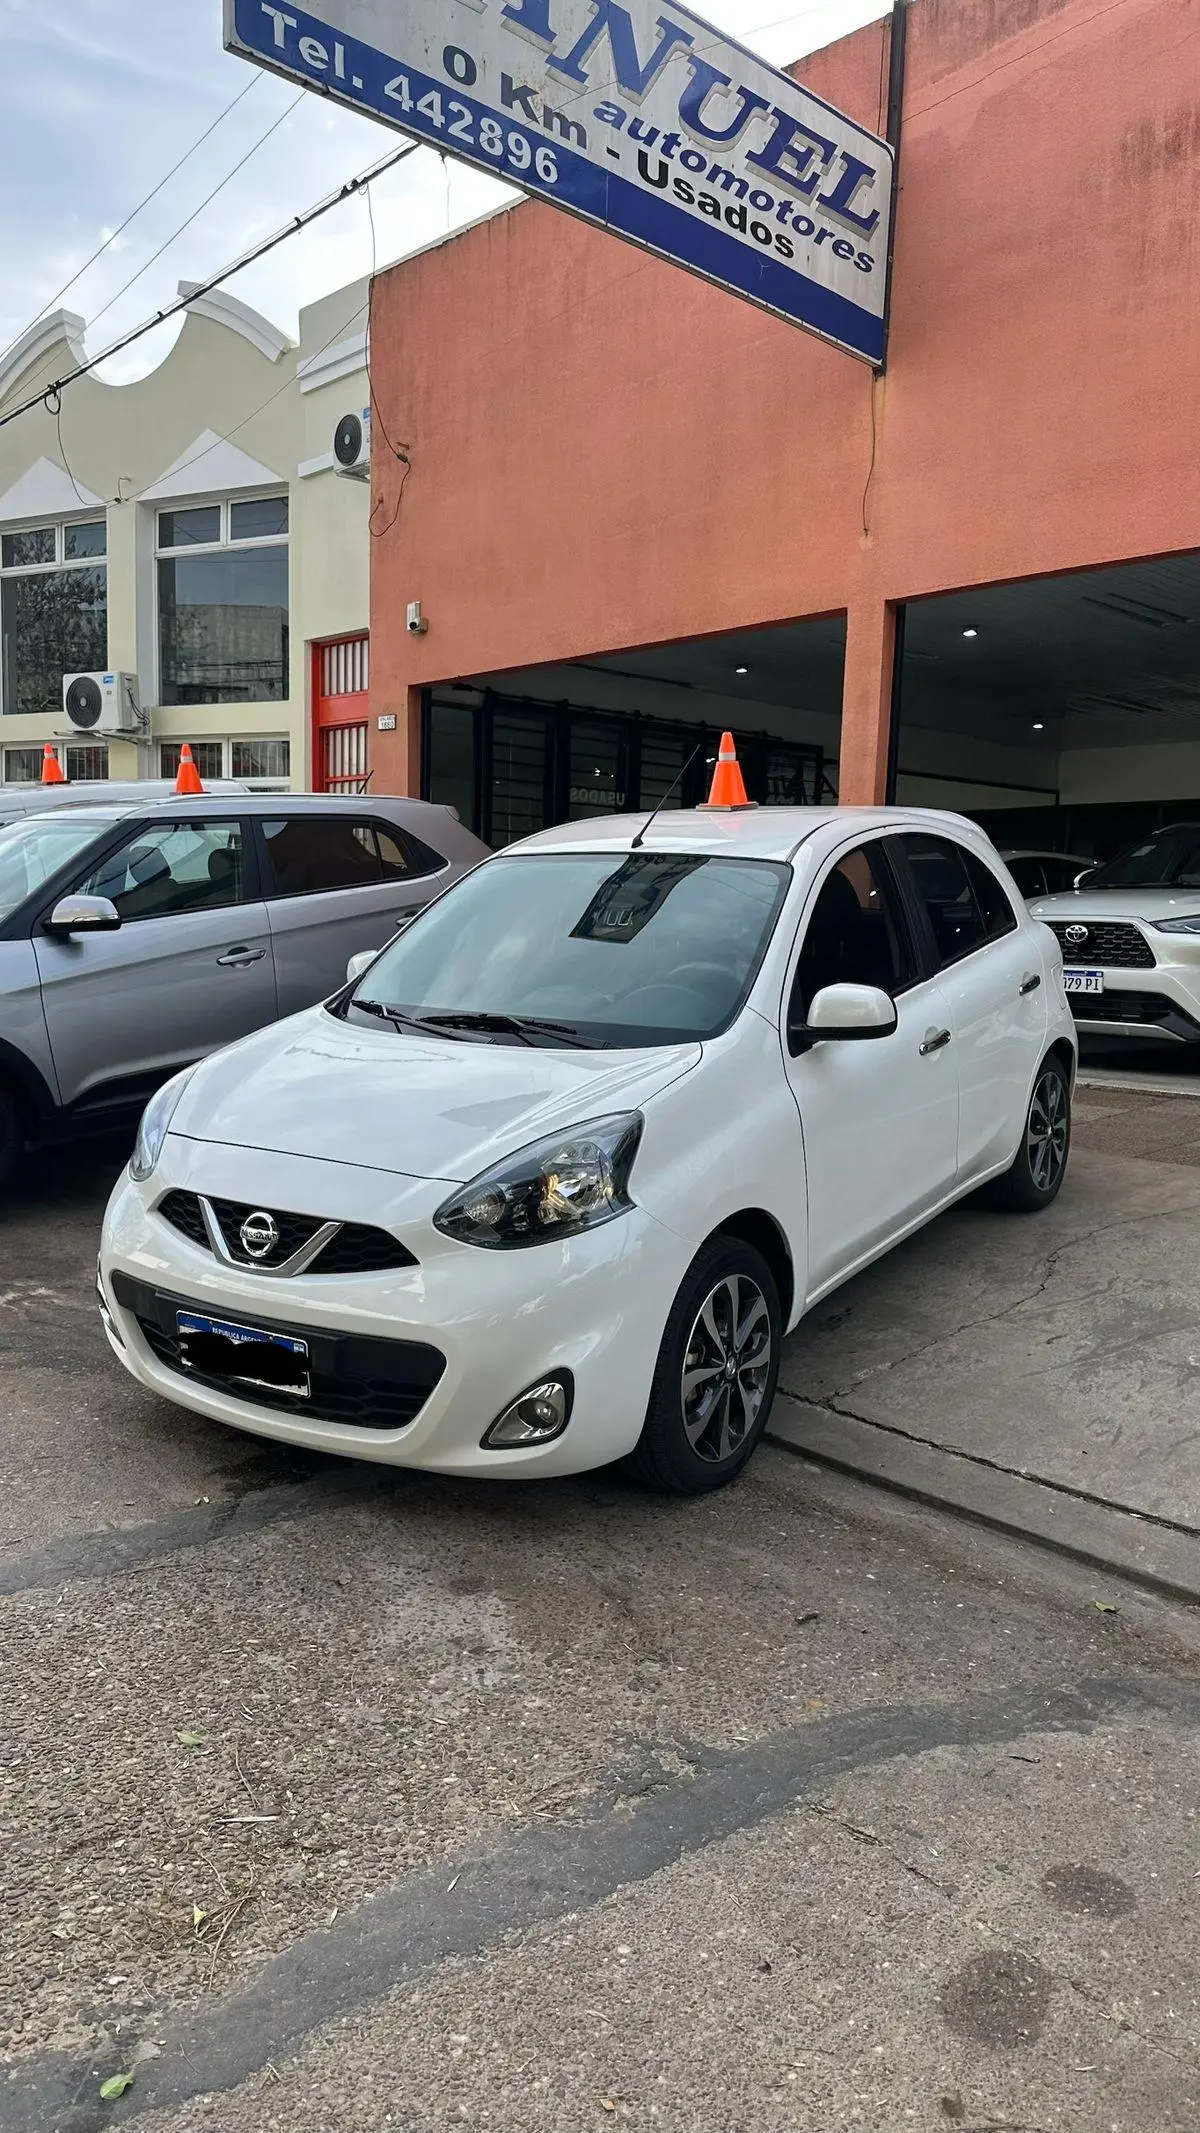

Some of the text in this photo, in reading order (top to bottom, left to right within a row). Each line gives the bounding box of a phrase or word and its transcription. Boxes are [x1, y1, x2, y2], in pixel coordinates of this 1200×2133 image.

[261, 5, 558, 184] Tel. 442896
[500, 72, 588, 150] Km
[637, 150, 795, 259] Usados
[593, 99, 875, 274] automotores
[1085, 978, 1098, 990] PI
